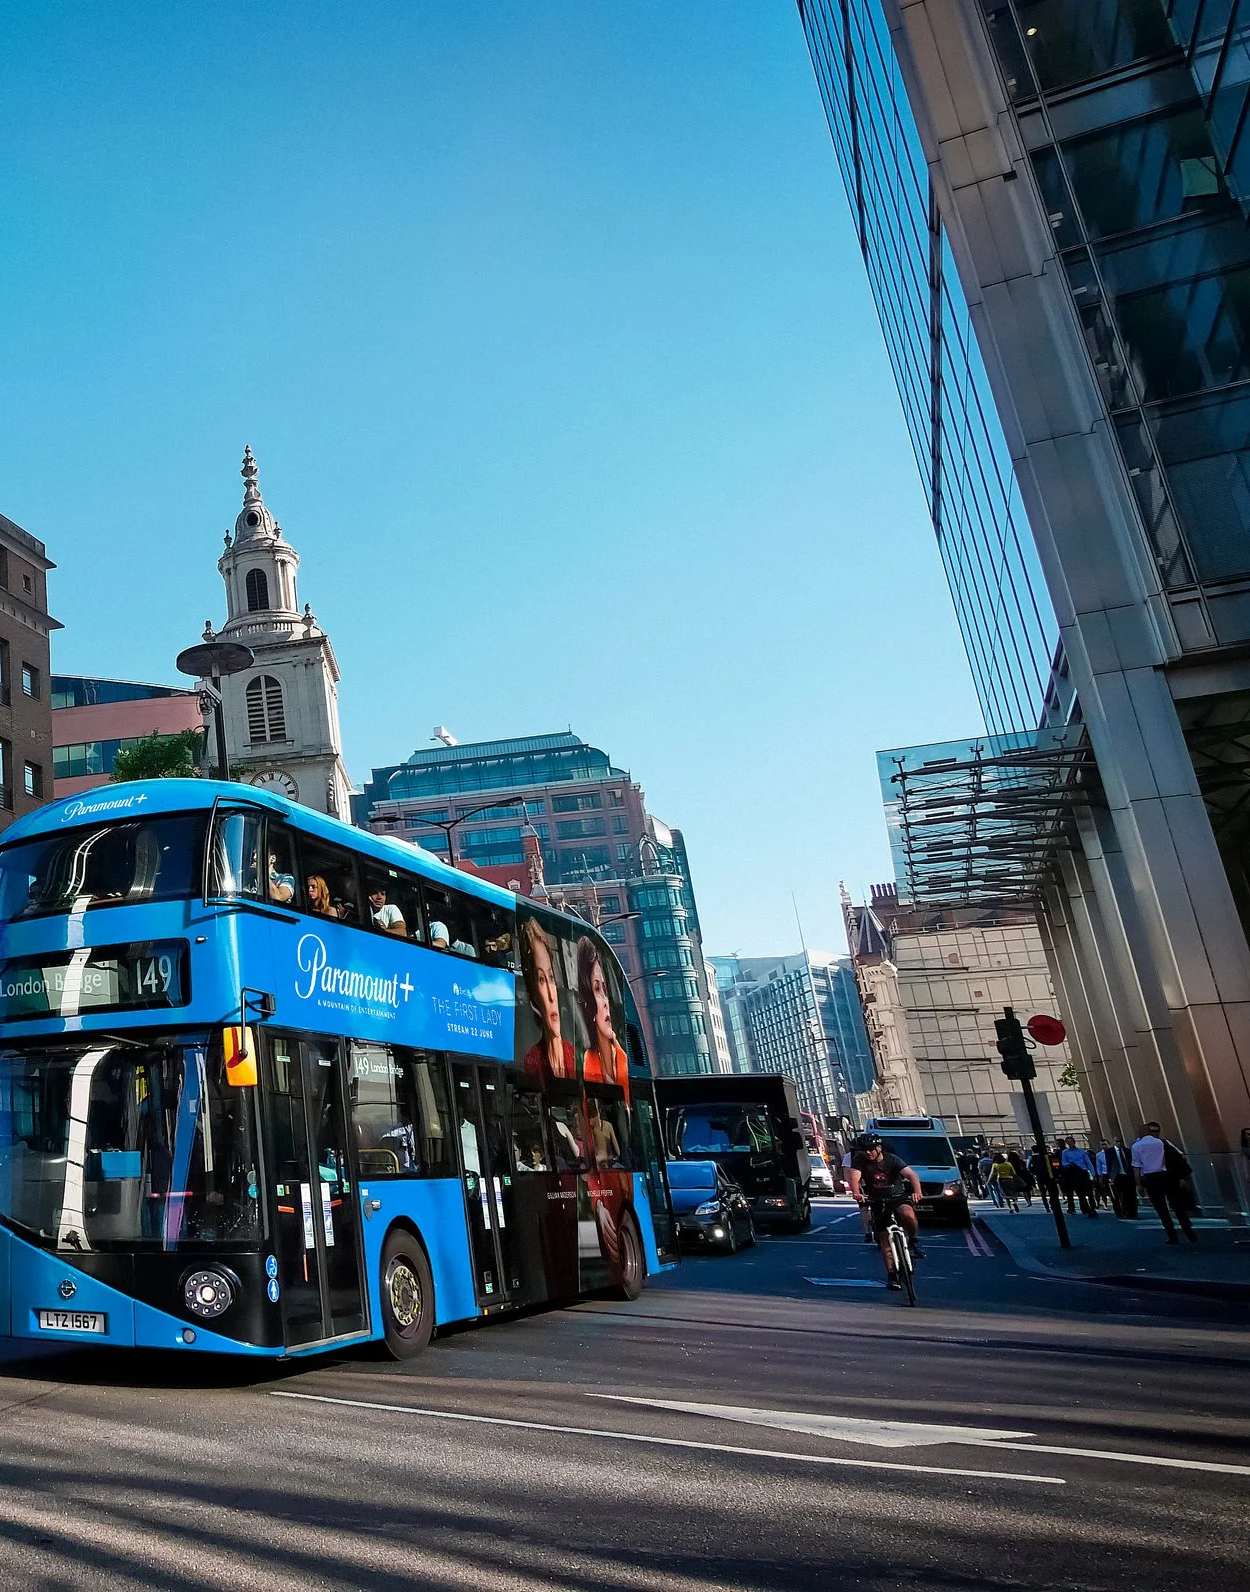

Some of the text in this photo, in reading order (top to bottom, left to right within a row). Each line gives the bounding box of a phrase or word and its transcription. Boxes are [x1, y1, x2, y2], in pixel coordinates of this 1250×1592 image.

[136, 955, 172, 995] 149
[294, 933, 415, 1009] Paramount+
[0, 976, 50, 998] London
[323, 1000, 350, 1012] MOUNTAIN
[431, 996, 503, 1027] THE FIRST LADY
[447, 1023, 494, 1039] STREAM 22 JUNE
[354, 1056, 370, 1076] 149
[46, 1313, 97, 1330] LTZ 1567
